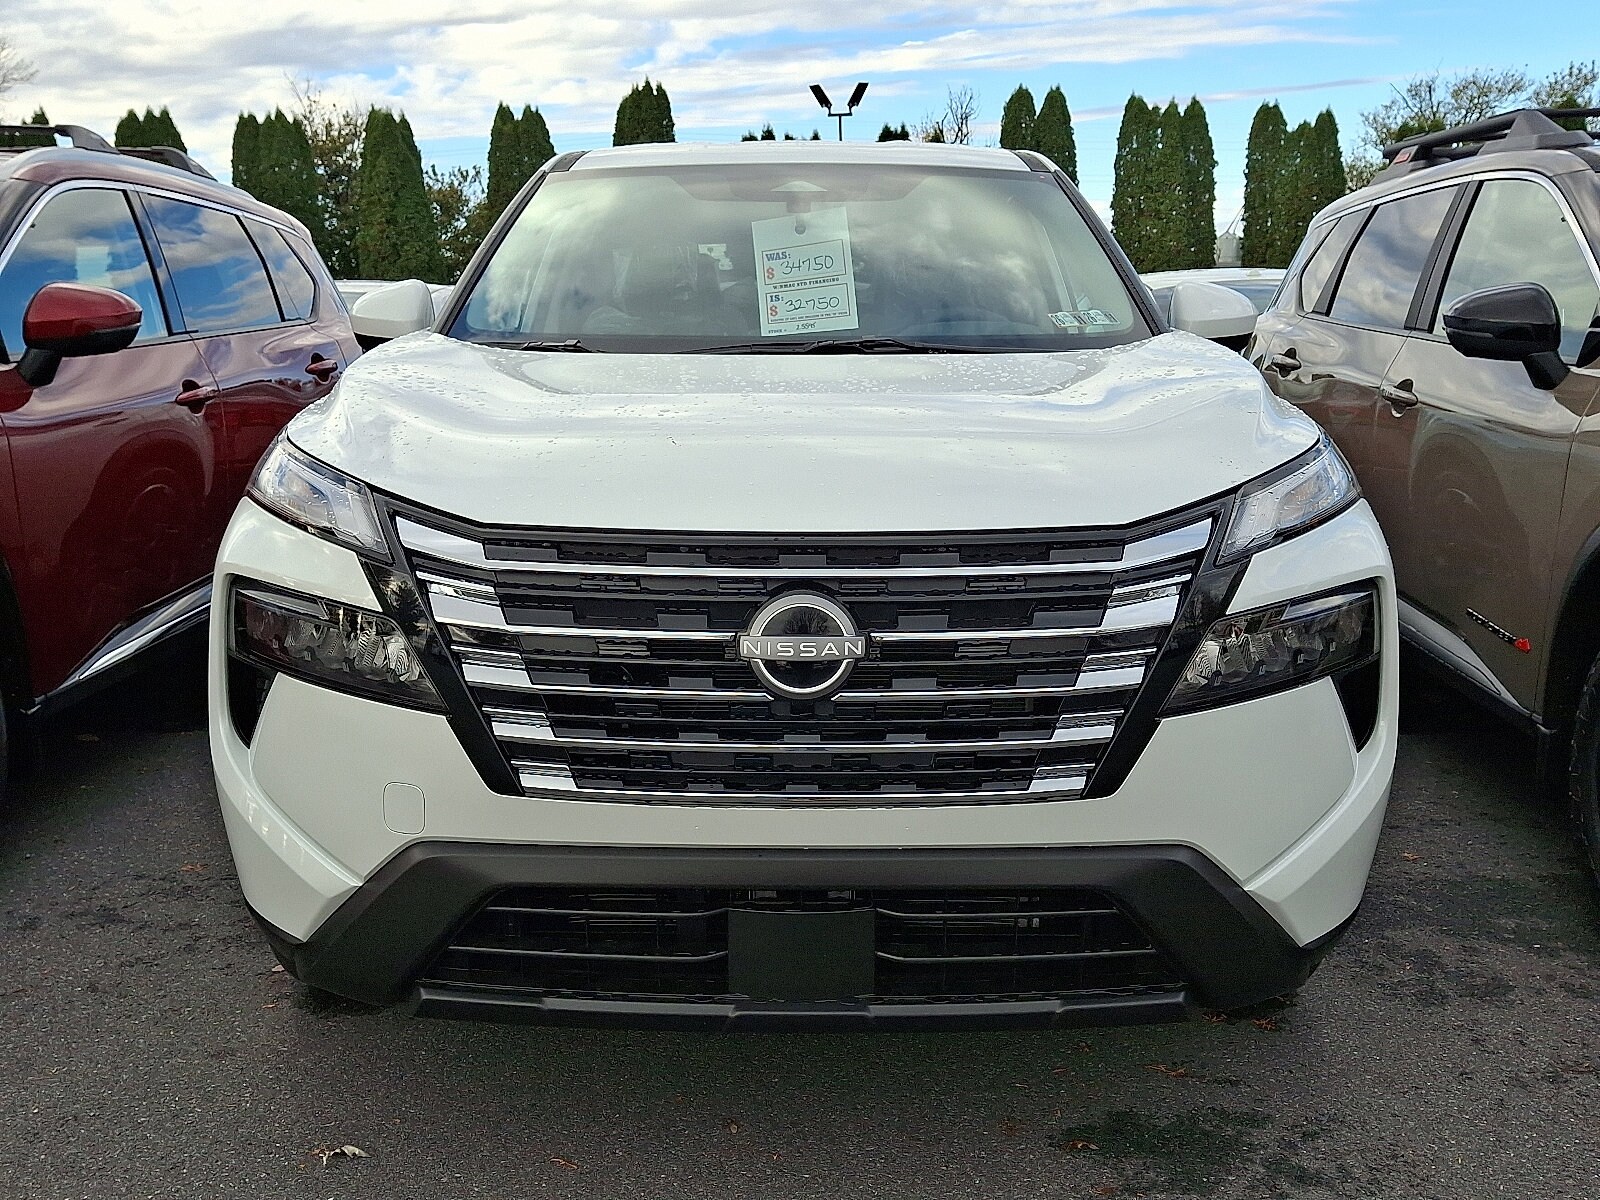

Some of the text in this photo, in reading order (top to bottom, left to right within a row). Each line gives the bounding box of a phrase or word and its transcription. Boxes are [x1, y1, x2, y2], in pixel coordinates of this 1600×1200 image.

[765, 251, 791, 262] WAS:
[766, 255, 834, 280] $ 34750
[809, 277, 840, 286] FINANCING
[769, 294, 784, 303] IS:
[769, 304, 778, 317] $
[784, 296, 840, 313] 32750
[743, 640, 862, 656] NISSAN
